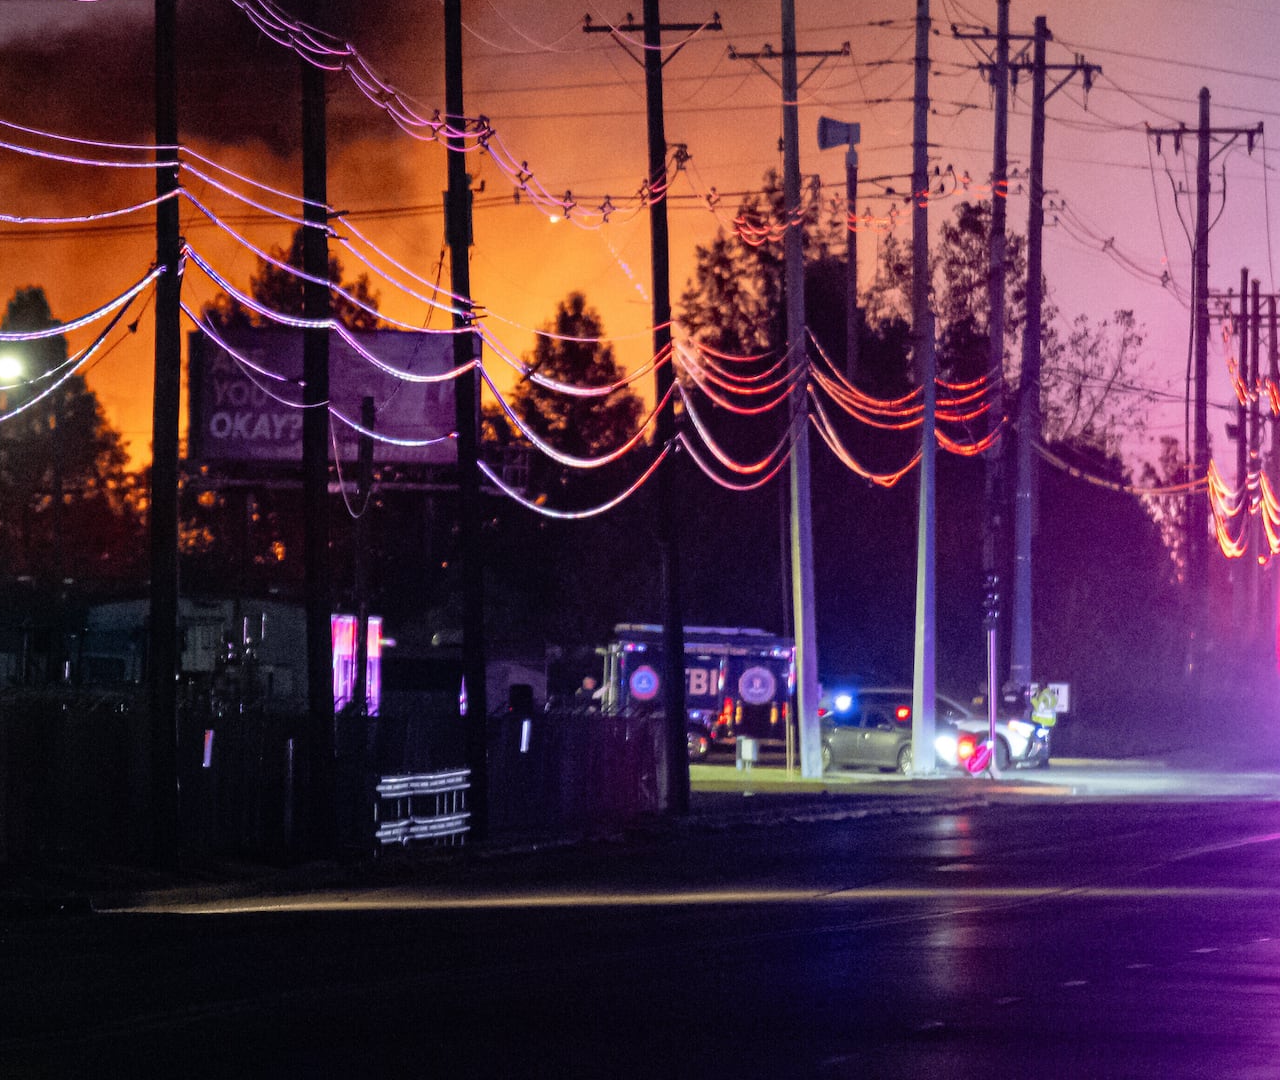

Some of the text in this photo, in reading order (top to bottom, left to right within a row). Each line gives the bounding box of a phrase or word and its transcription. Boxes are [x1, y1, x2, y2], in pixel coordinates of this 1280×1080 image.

[213, 379, 268, 407] YOU
[209, 411, 303, 439] OKAY?
[685, 668, 718, 696] BI
